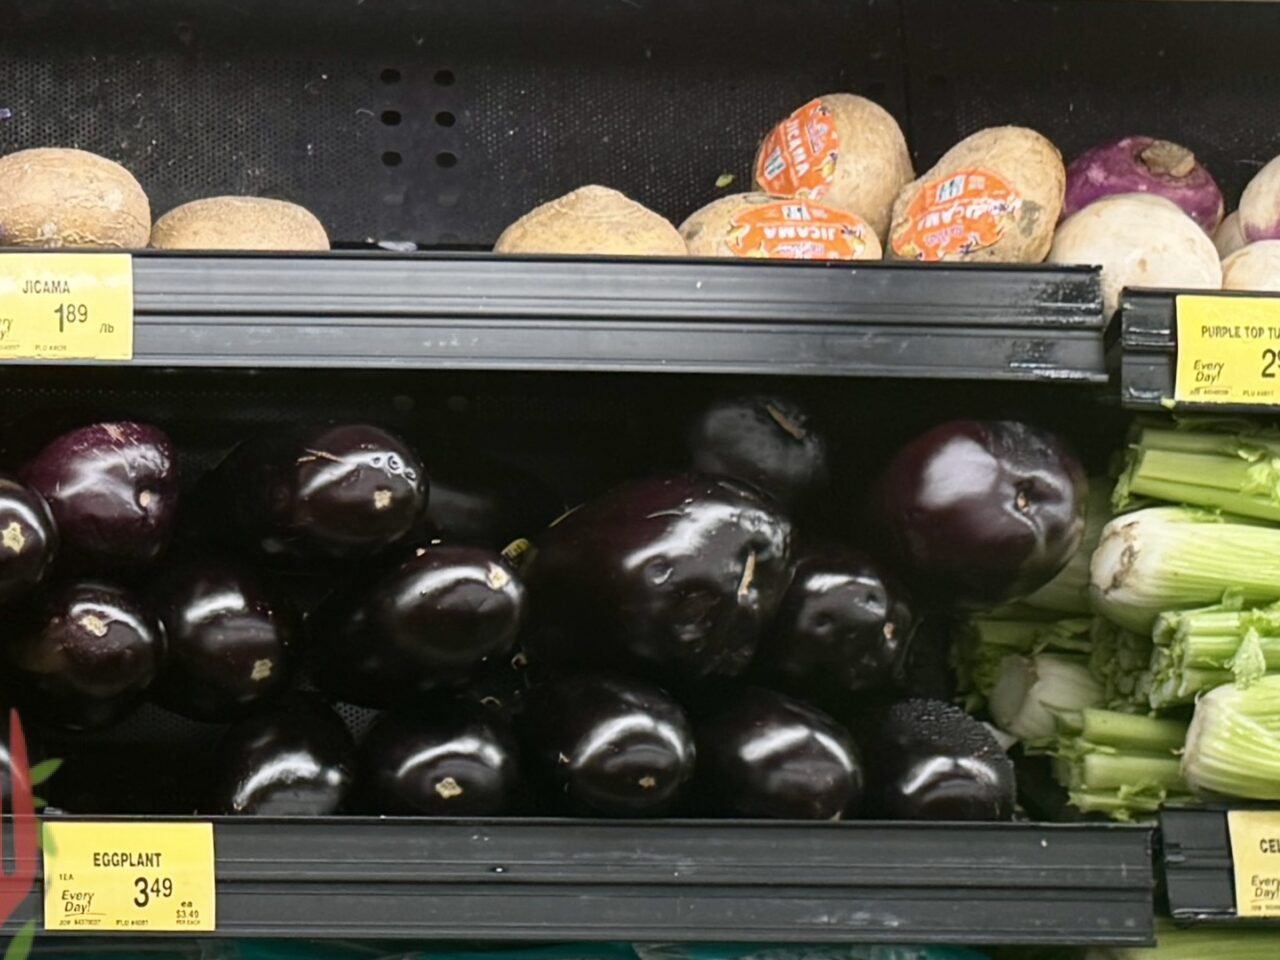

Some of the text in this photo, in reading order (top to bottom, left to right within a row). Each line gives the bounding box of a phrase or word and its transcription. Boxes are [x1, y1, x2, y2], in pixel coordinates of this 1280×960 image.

[786, 119, 810, 177] JICAMA
[763, 225, 837, 240] JICAMA
[22, 280, 71, 294] JICAMA
[99, 323, 115, 333] /lb
[1201, 325, 1242, 338] PURPLE
[1244, 326, 1265, 339] TOP
[1193, 359, 1225, 373] Every
[1261, 348, 1280, 378] 2
[1195, 370, 1221, 384] Day!
[93, 852, 162, 867] EGGPLANT
[61, 889, 95, 903] Every
[64, 901, 91, 914] Day!
